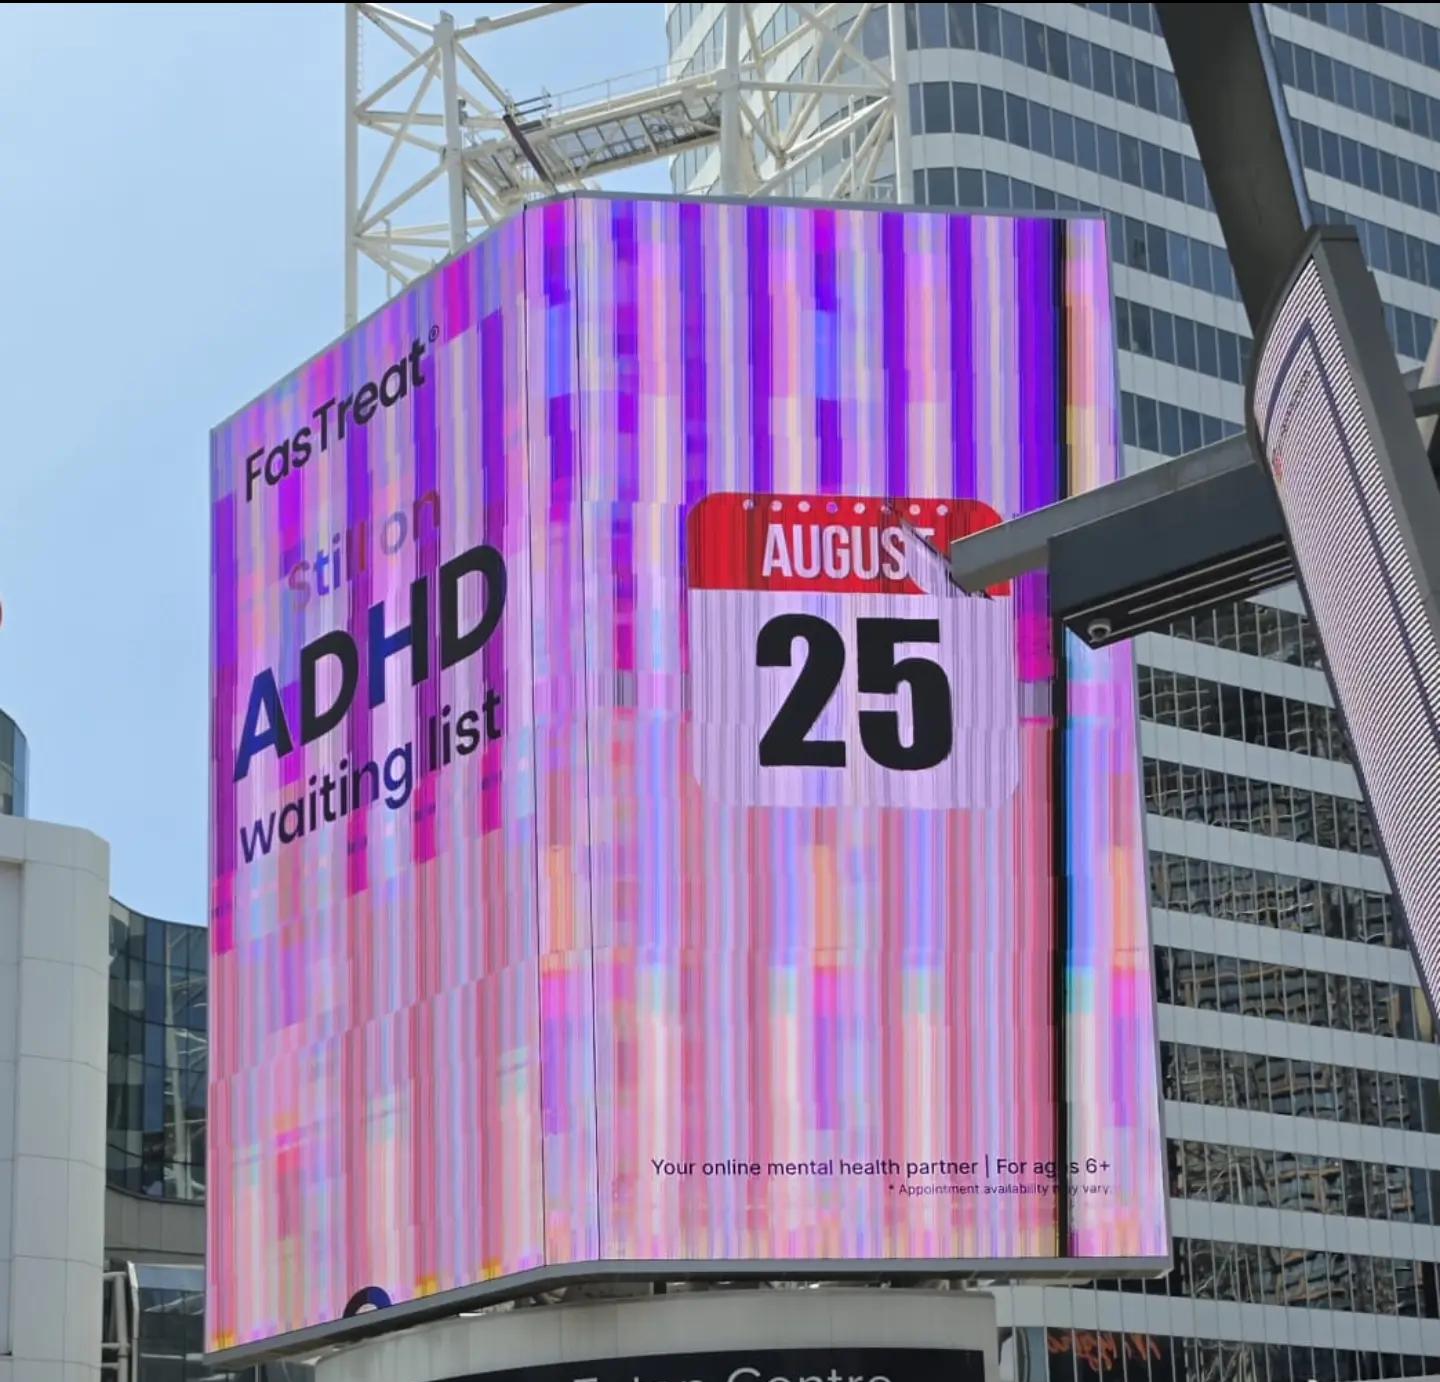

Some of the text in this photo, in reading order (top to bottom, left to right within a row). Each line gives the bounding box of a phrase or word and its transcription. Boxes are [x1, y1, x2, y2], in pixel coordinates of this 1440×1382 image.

[380, 490, 440, 556] on
[233, 545, 508, 782] ADHD
[756, 613, 953, 770] 25
[240, 689, 502, 863] waiting list
[651, 1159, 695, 1175] Your
[702, 1159, 761, 1175] online
[767, 1159, 833, 1175] mental
[840, 1159, 900, 1175] health
[907, 1160, 978, 1177] partner
[997, 1159, 1027, 1174] For
[1033, 1162, 1079, 1178] ags
[1086, 1158, 1110, 1174] 6+
[899, 1183, 978, 1197] Appointment
